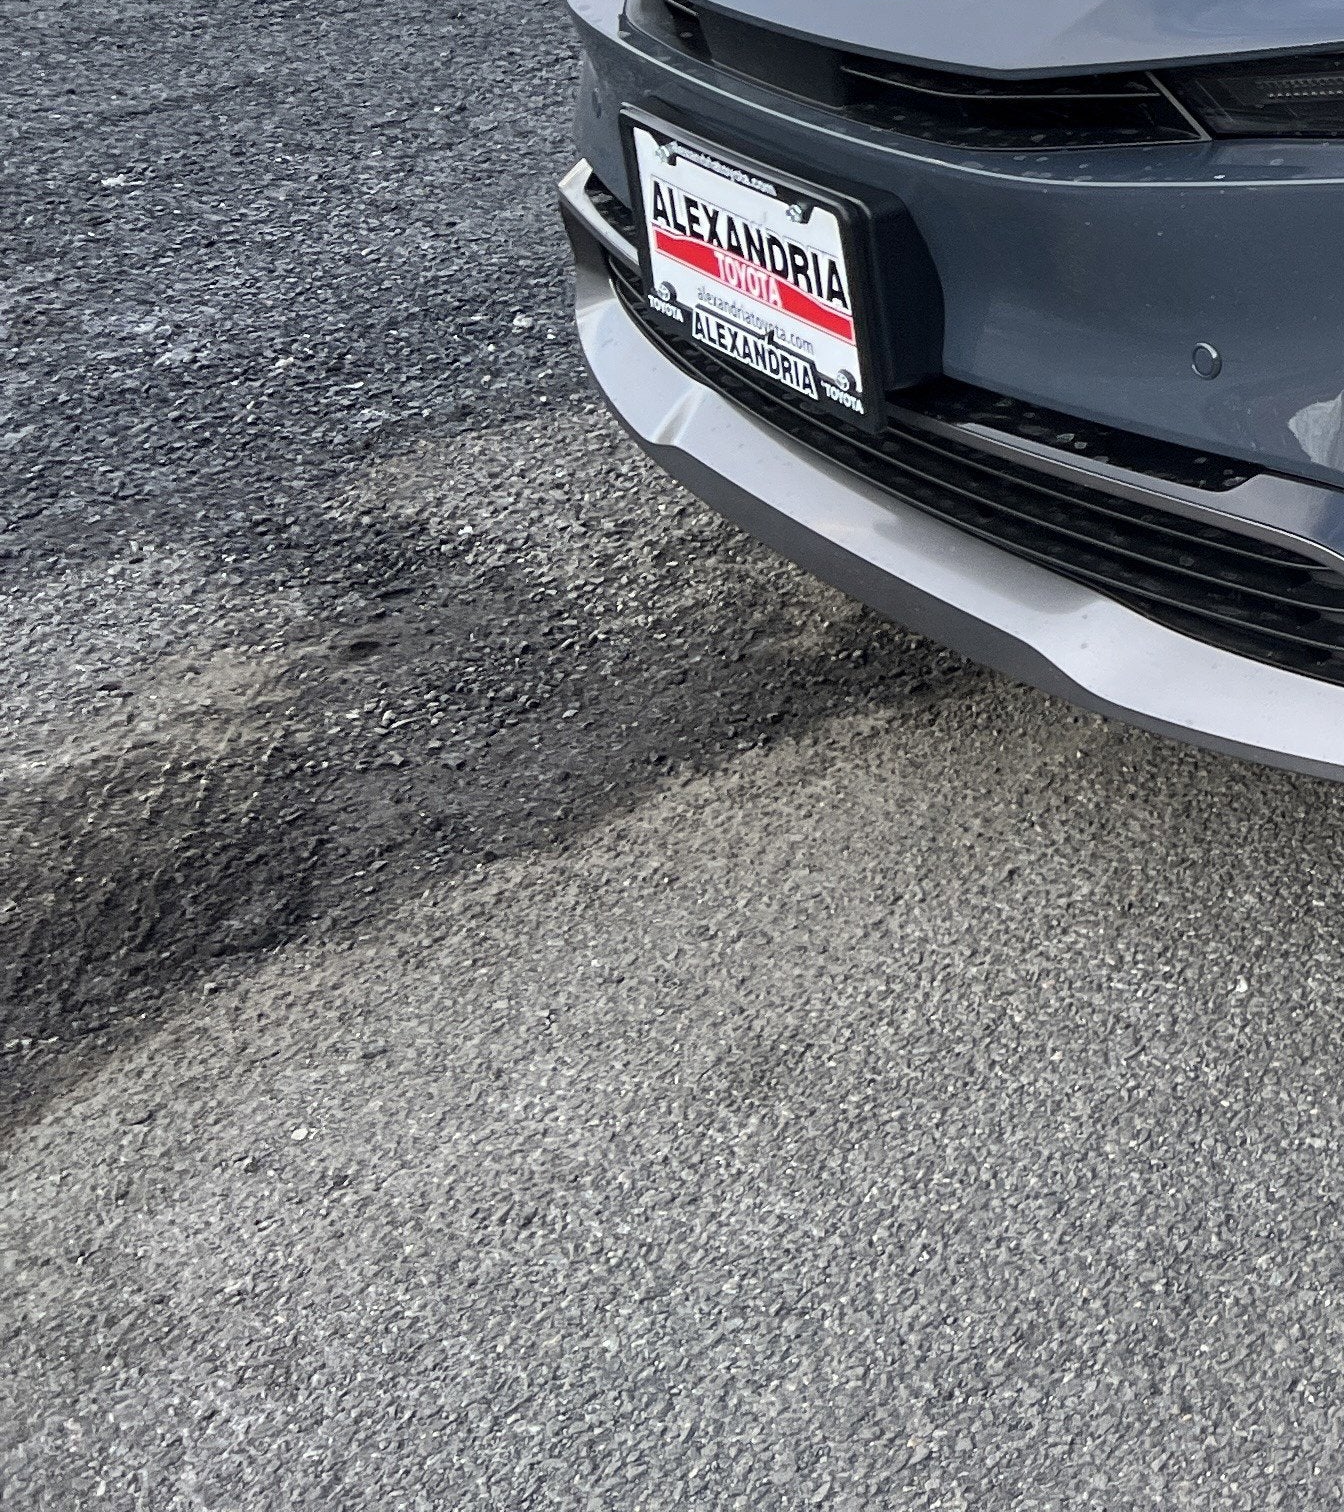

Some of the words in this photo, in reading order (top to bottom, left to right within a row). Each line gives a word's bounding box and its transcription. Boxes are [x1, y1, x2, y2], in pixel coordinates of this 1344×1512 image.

[652, 179, 850, 312] ALEXANDRIA
[648, 294, 684, 323] TOYOTA
[714, 250, 784, 309] TOYOTA
[694, 311, 815, 396] ALEXANDRIA
[821, 379, 865, 415] TOYOTA
